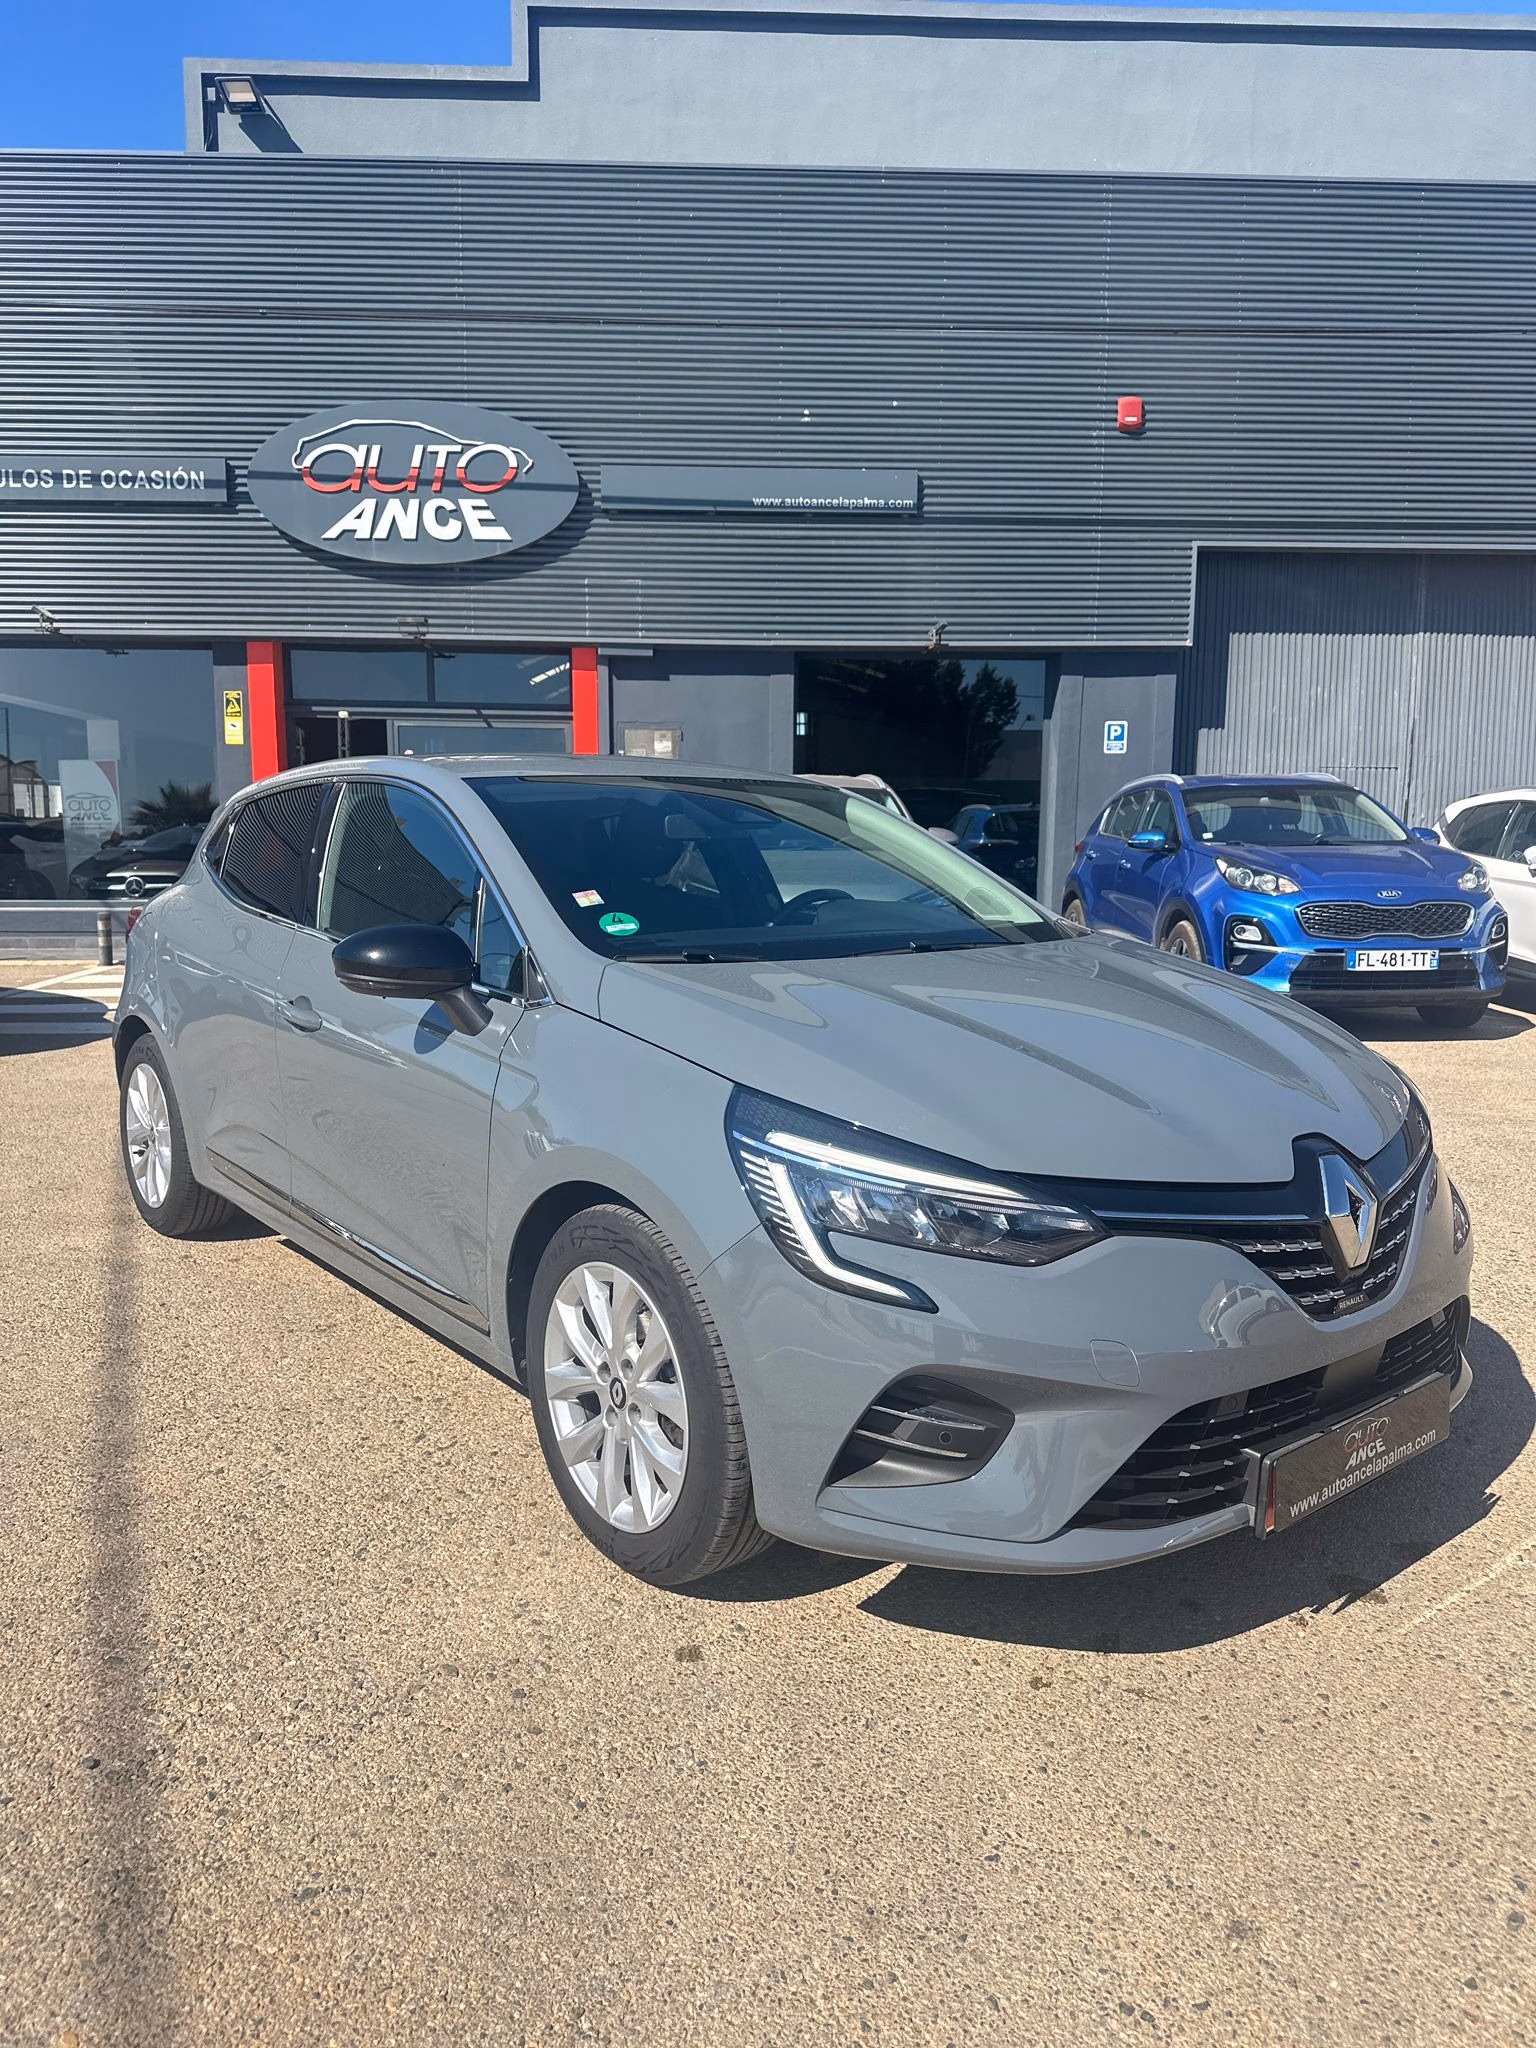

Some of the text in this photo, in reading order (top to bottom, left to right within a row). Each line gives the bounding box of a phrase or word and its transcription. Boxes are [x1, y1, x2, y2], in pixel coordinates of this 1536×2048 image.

[62, 470, 93, 489] DE
[100, 466, 205, 490] OCASIÓN
[752, 497, 913, 510] www.autoancelapalma.com
[321, 498, 513, 541] ANCE
[1110, 725, 1122, 740] P
[70, 811, 112, 822] ANCE
[1357, 952, 1428, 967] FL-481-TT
[1339, 1295, 1364, 1309] RENAULT
[1345, 1438, 1386, 1471] ANCE
[1290, 1429, 1436, 1517] www.autoancelapalma.com
